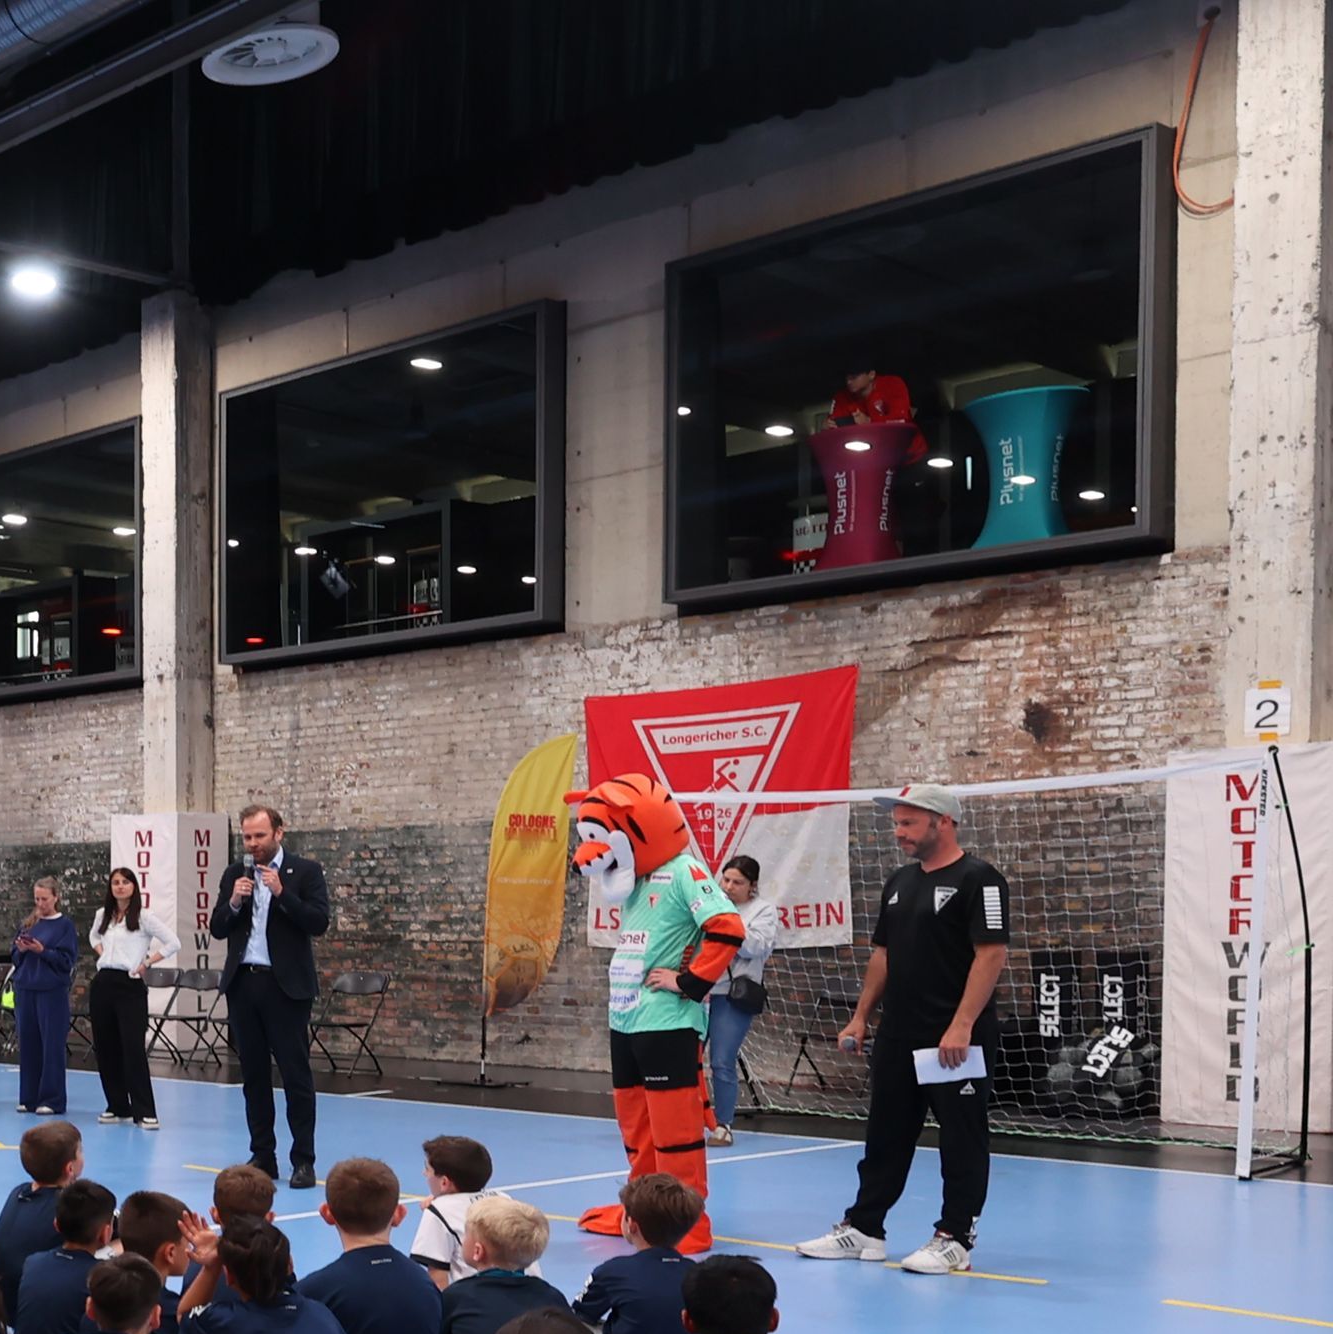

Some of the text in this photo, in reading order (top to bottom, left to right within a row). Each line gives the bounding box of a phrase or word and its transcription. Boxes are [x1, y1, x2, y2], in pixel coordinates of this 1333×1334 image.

[1000, 437, 1014, 506] Plusnet
[834, 471, 847, 535] Plusnet
[1254, 700, 1279, 729] 2
[662, 726, 767, 746] Longericher S.C.
[1260, 769, 1268, 817] KICKSTER
[509, 814, 556, 829] COLOGNE
[594, 907, 623, 930] LS
[776, 901, 844, 928] REIN
[1040, 973, 1060, 1037] SELECT
